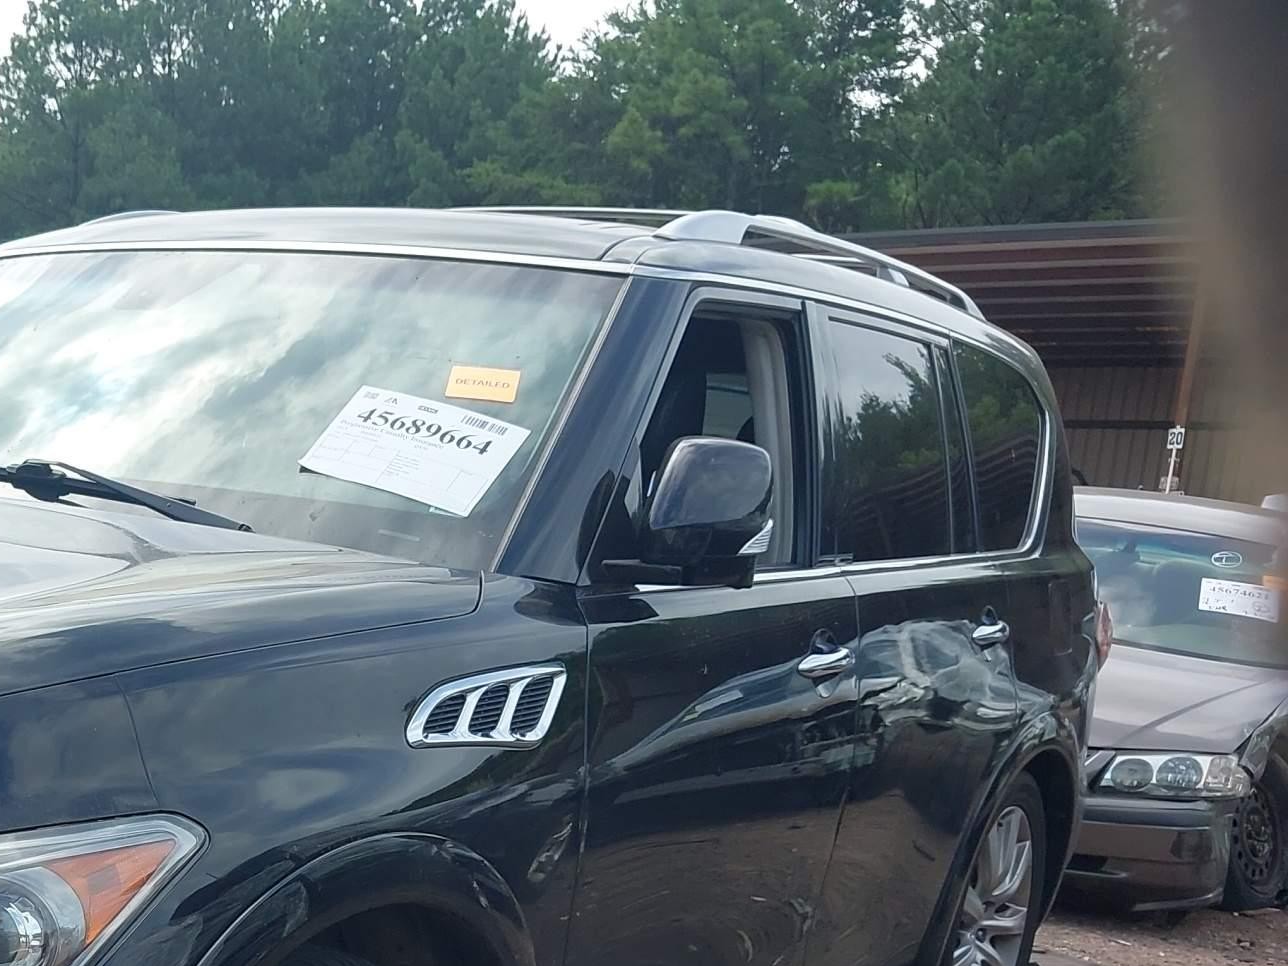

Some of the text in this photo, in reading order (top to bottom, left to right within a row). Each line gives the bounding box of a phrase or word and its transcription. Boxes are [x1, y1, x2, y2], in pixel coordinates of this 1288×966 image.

[455, 377, 511, 389] DETAILED
[357, 407, 493, 456] 45689664
[1168, 431, 1184, 446] 20
